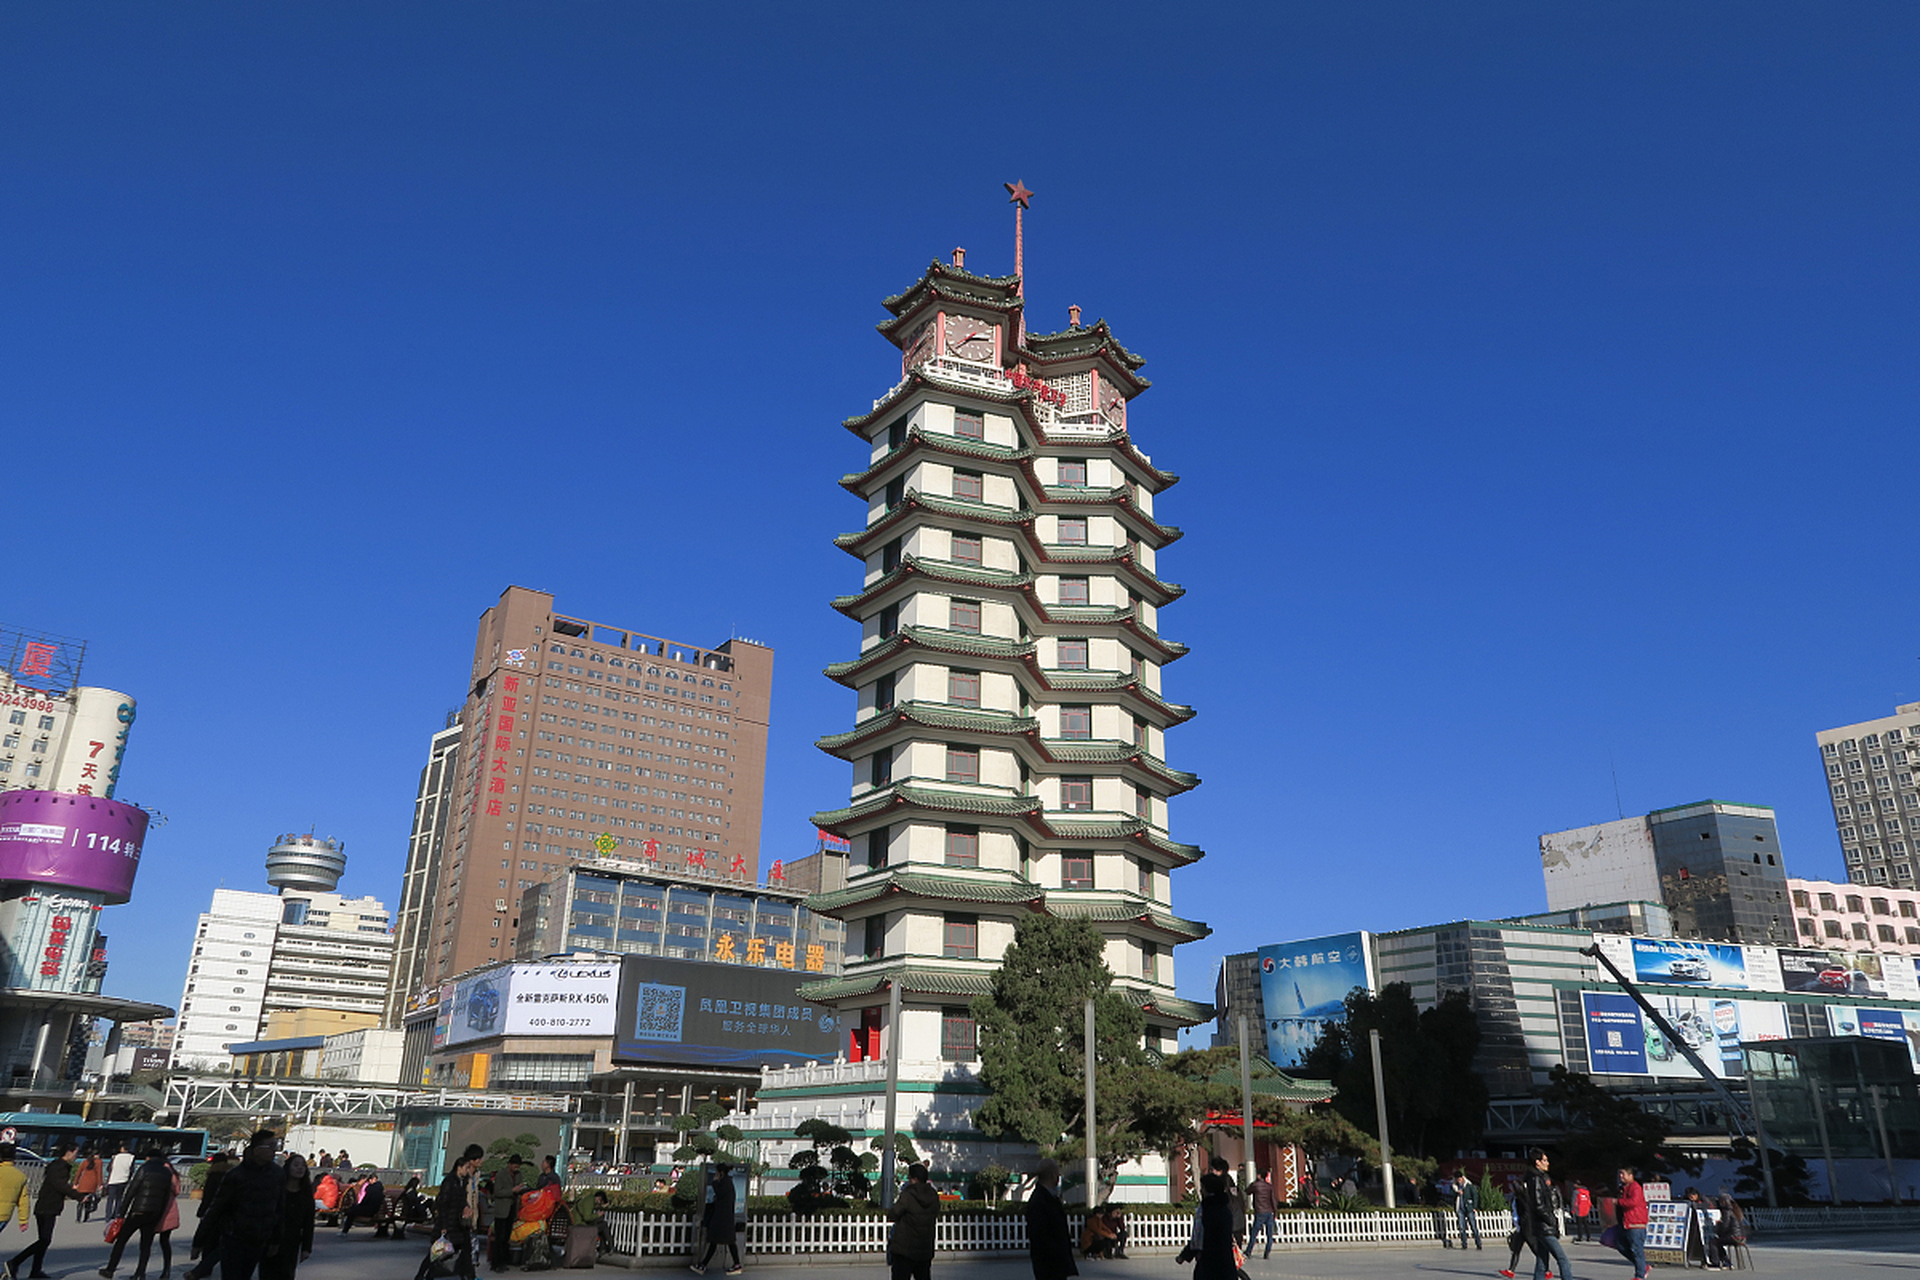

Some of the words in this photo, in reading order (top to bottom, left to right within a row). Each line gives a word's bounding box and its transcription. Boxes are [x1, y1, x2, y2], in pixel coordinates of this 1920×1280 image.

[18, 642, 58, 678] 厦
[485, 675, 520, 817] 新亚国际大酒店
[642, 838, 786, 881] 商城大厦
[40, 915, 72, 976] 国美电器
[715, 934, 825, 972] 永乐电器
[569, 970, 612, 978] LEXUS
[529, 1018, 592, 1027] 400-810-2772
[699, 998, 813, 1022] 凤凰卫视集团成员
[721, 1019, 792, 1036] 服务全球华人
